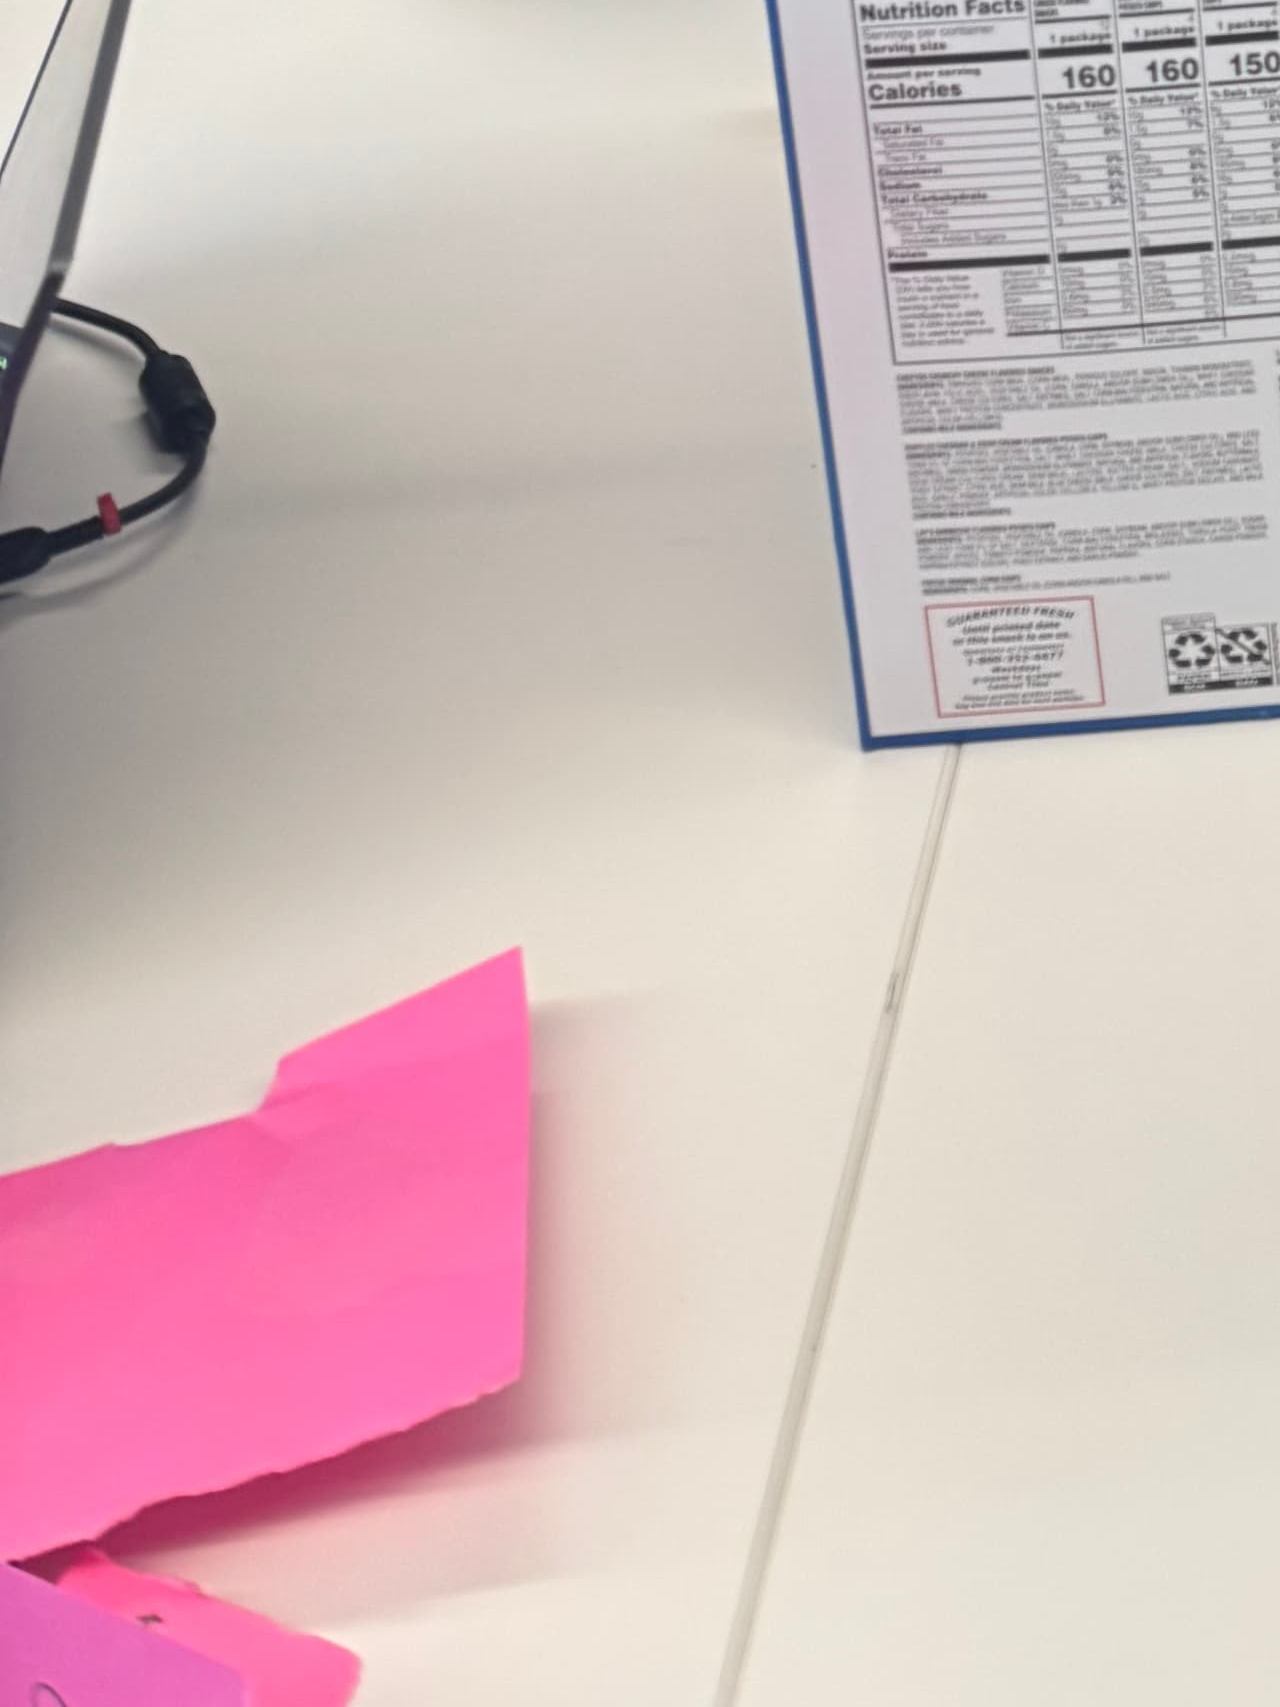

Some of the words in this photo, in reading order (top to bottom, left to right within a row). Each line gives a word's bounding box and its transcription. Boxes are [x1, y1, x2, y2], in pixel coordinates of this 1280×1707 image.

[860, 0, 959, 23] Nutrition
[863, 40, 917, 55] Serving
[919, 39, 948, 52] size
[868, 70, 913, 80] Amount
[938, 65, 981, 77] serving
[1062, 65, 1116, 90] 160
[1146, 58, 1199, 84] 160
[868, 81, 962, 101] Calories
[873, 124, 905, 135] Total
[877, 165, 943, 177] Cholesterol
[880, 180, 922, 191] Sodium
[881, 193, 910, 204] Total
[913, 190, 988, 204] Carbohydrate
[887, 249, 928, 260] Protein
[945, 605, 1031, 627] GUARANTEED
[1033, 606, 1075, 620] FRESH
[962, 623, 988, 636] Until
